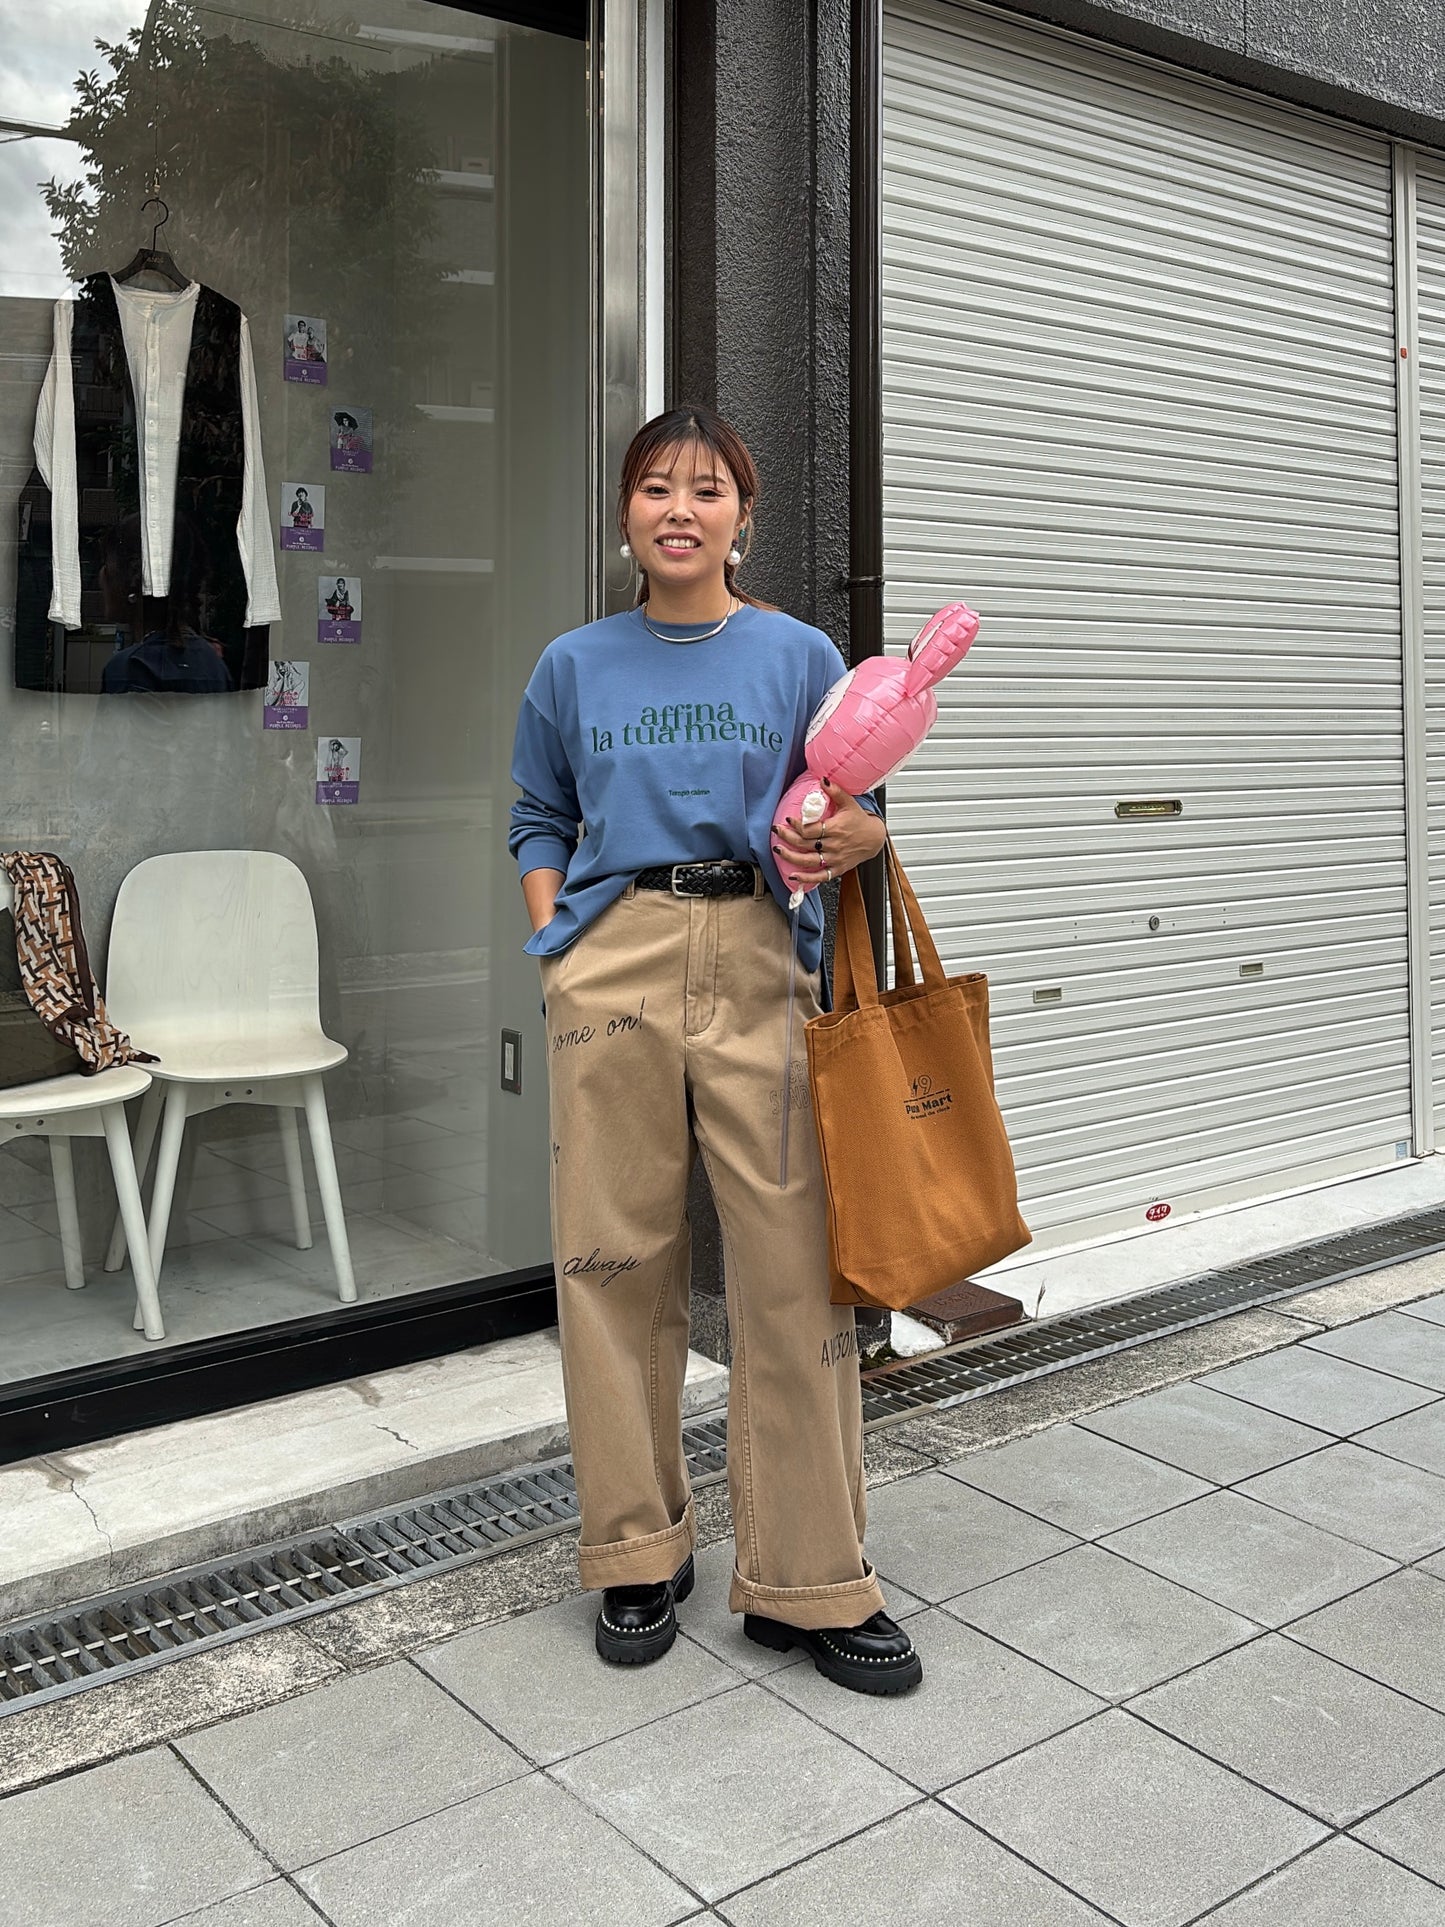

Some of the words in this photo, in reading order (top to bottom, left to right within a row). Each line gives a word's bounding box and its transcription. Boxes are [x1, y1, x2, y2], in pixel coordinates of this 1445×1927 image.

[640, 702, 736, 731] affina
[591, 726, 614, 754] la
[621, 722, 676, 746] tua
[684, 721, 784, 753] mente
[607, 996, 646, 1037] on!
[922, 1093, 953, 1111] Mart
[563, 1247, 642, 1288] always
